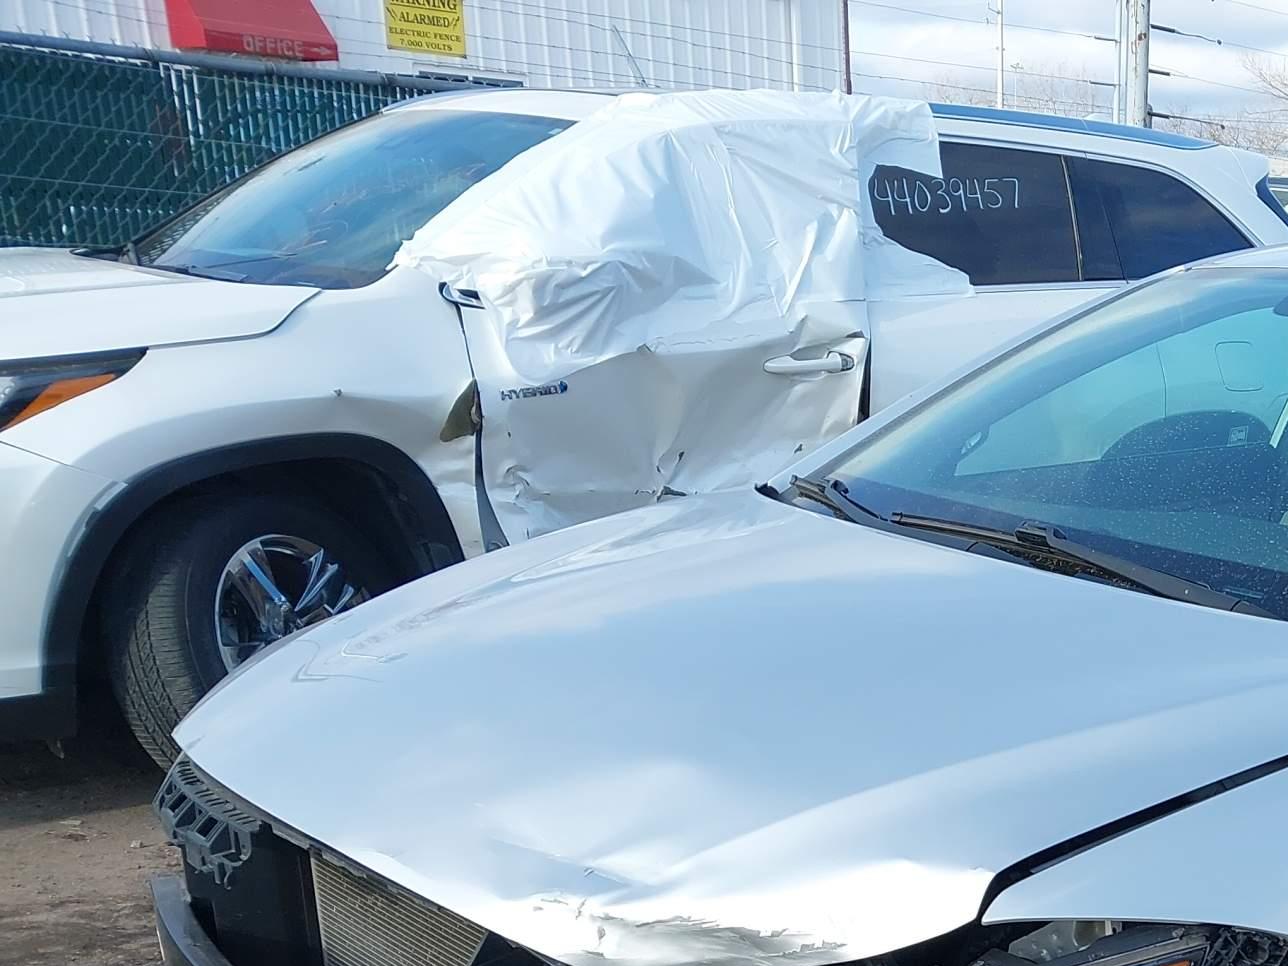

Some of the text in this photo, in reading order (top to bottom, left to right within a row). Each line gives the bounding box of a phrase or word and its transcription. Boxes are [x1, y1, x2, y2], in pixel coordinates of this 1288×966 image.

[391, 0, 457, 10] NING
[399, 12, 450, 28] ALARMED
[388, 26, 462, 43] ELECTRIC FENCE
[242, 34, 304, 58] OFFICE
[425, 41, 453, 51] VOLTS
[874, 177, 1019, 215] 44039457
